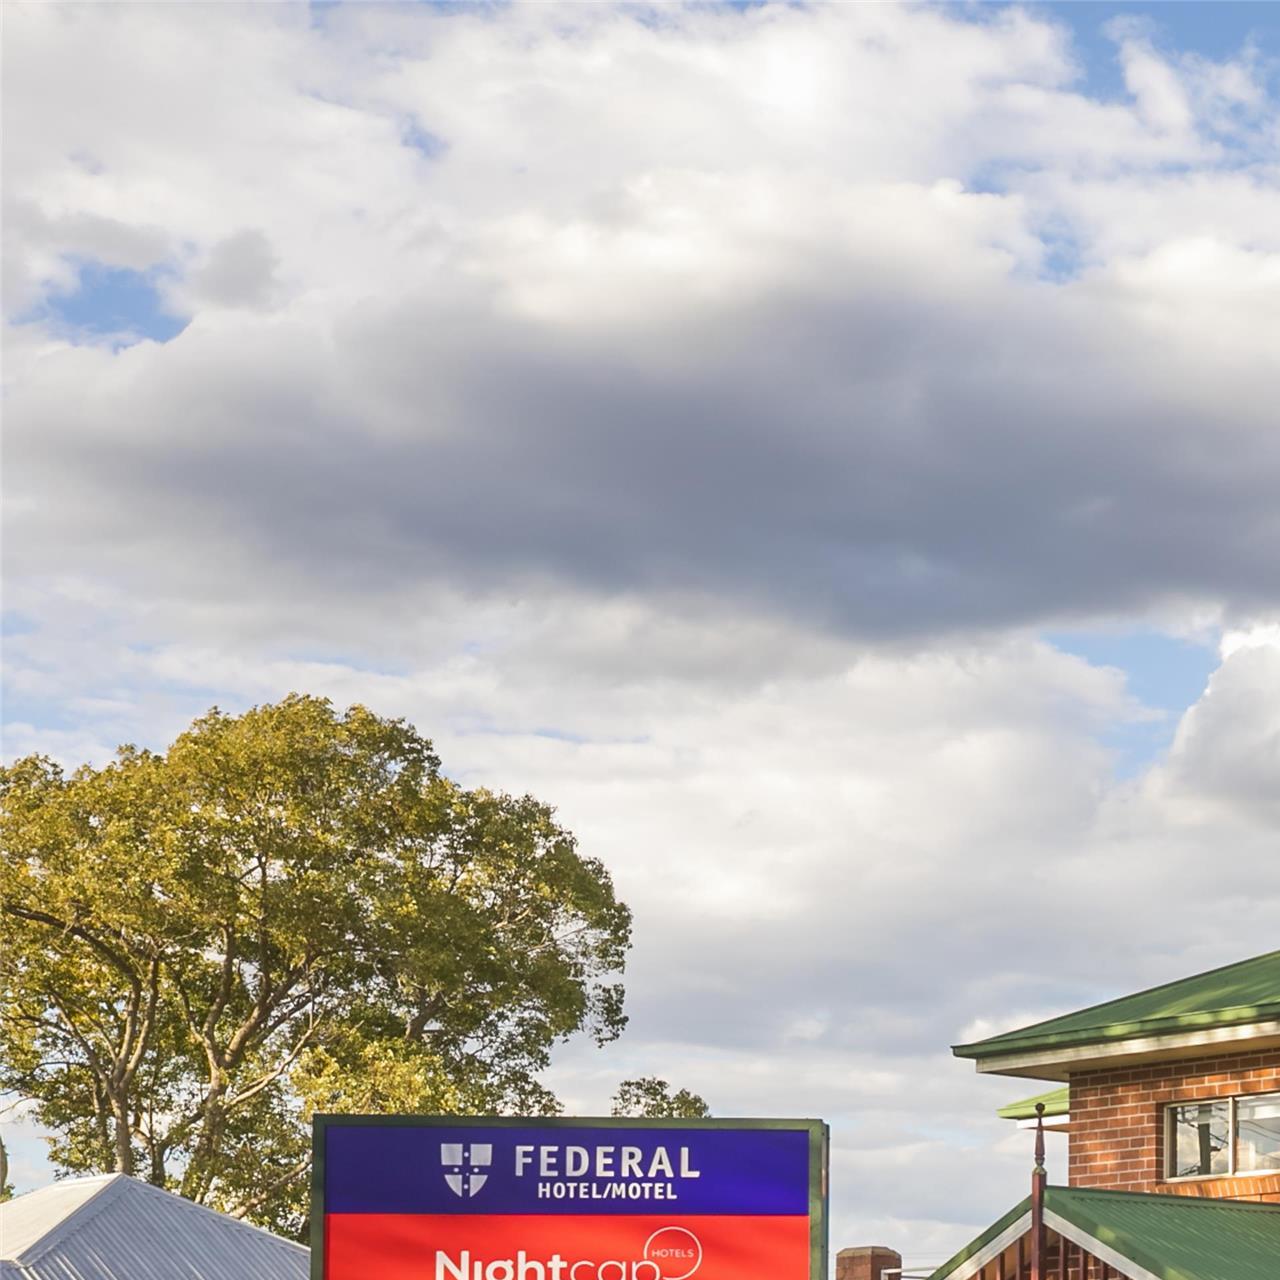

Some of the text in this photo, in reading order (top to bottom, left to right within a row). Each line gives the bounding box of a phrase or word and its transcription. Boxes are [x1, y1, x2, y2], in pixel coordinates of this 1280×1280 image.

[515, 1145, 701, 1178] FEDERAL
[537, 1182, 678, 1200] HOTEL/MOTEL
[651, 1248, 695, 1258] HOTELS
